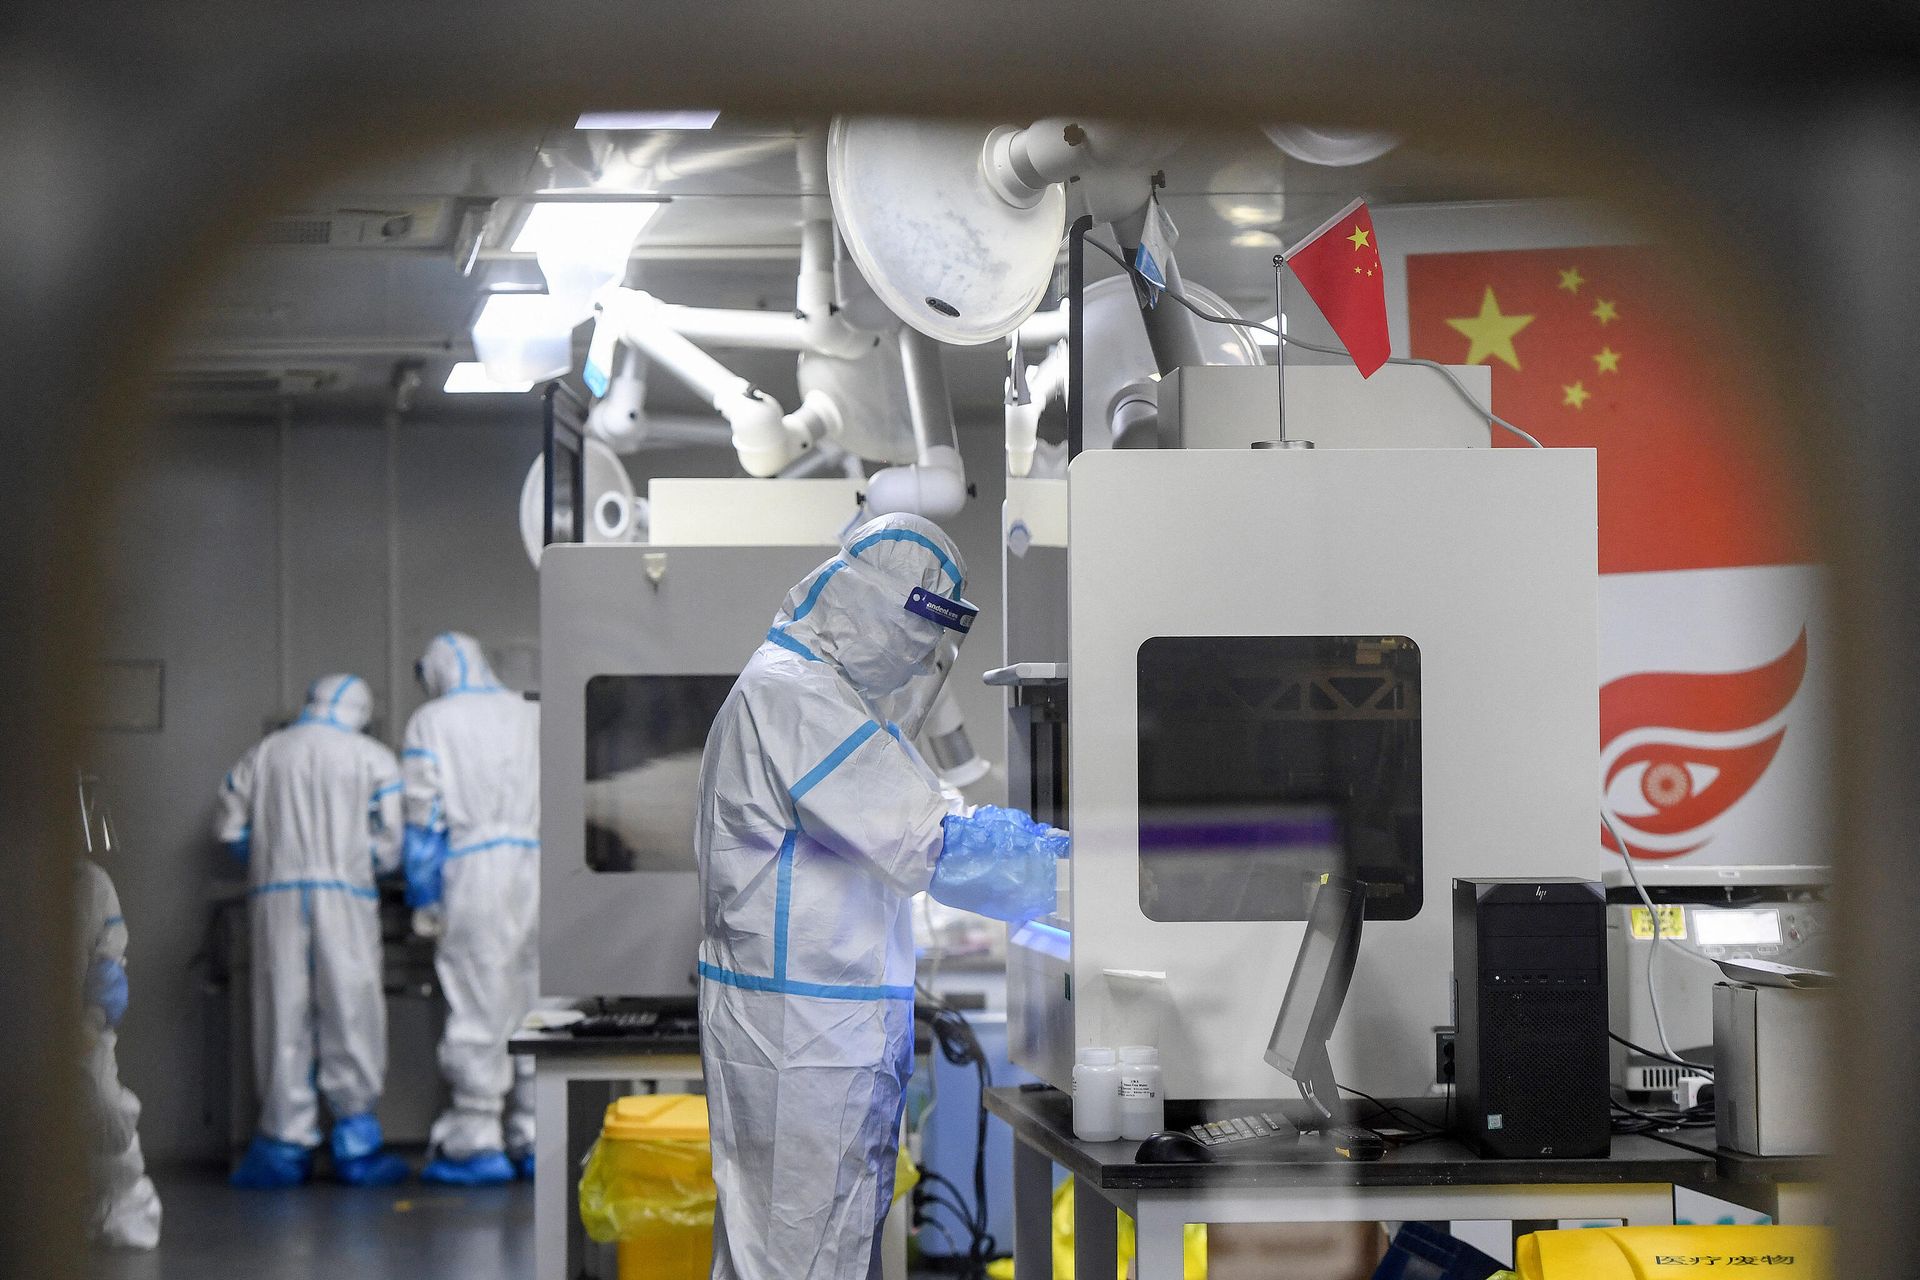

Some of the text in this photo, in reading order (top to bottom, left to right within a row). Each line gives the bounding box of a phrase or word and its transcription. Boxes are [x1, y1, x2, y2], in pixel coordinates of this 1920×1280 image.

[1535, 885, 1547, 901] hp
[1655, 1254, 1794, 1266] 医疗废物
